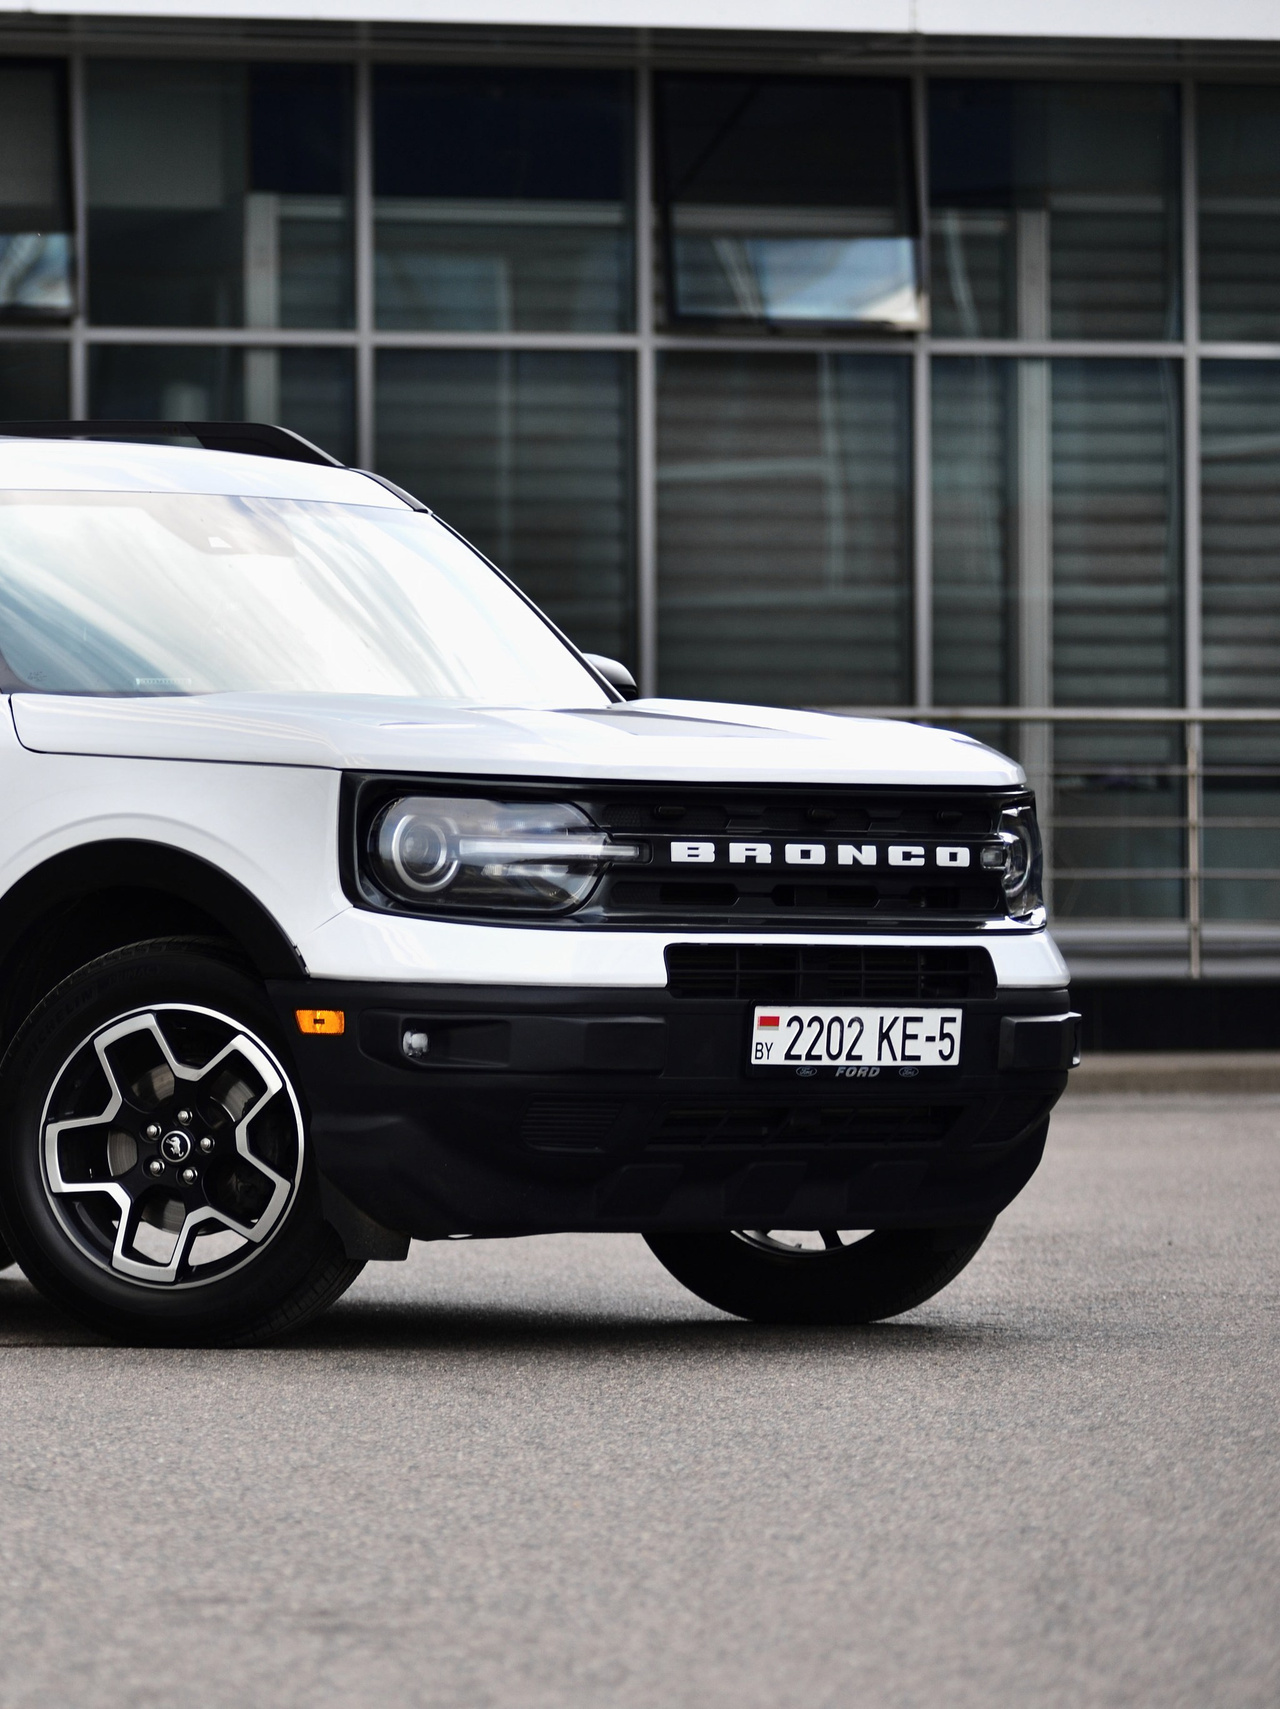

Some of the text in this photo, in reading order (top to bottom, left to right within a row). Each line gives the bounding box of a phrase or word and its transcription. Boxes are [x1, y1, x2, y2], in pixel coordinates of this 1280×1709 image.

[671, 841, 970, 868] BRONCO
[23, 986, 95, 1065] MICHELIN
[784, 1015, 957, 1061] 2202 KE-5
[754, 1042, 773, 1060] BY
[798, 1067, 816, 1077] Ford
[835, 1067, 880, 1078] FORD
[900, 1067, 918, 1077] Ford
